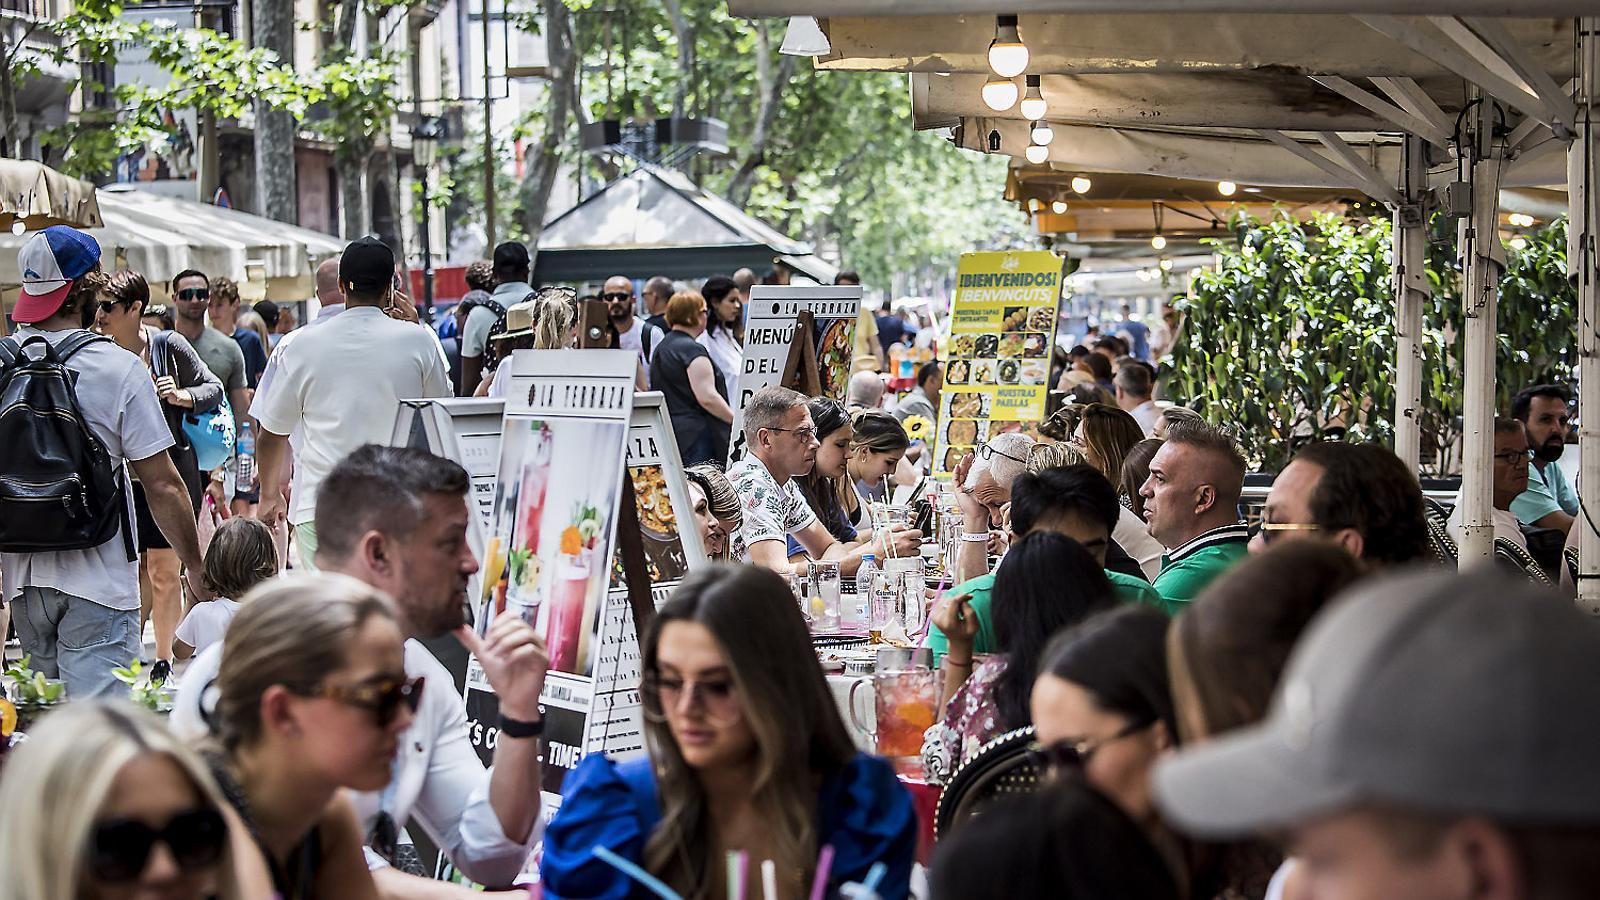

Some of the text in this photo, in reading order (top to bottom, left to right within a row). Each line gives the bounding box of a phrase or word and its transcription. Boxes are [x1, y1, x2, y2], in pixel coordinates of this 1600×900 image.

[785, 302, 856, 314] LA TERRAZA
[749, 323, 794, 345] MENÚ
[745, 358, 778, 374] DEL
[997, 389, 1036, 397] NUESTRAS
[995, 399, 1028, 407] PAELLAS
